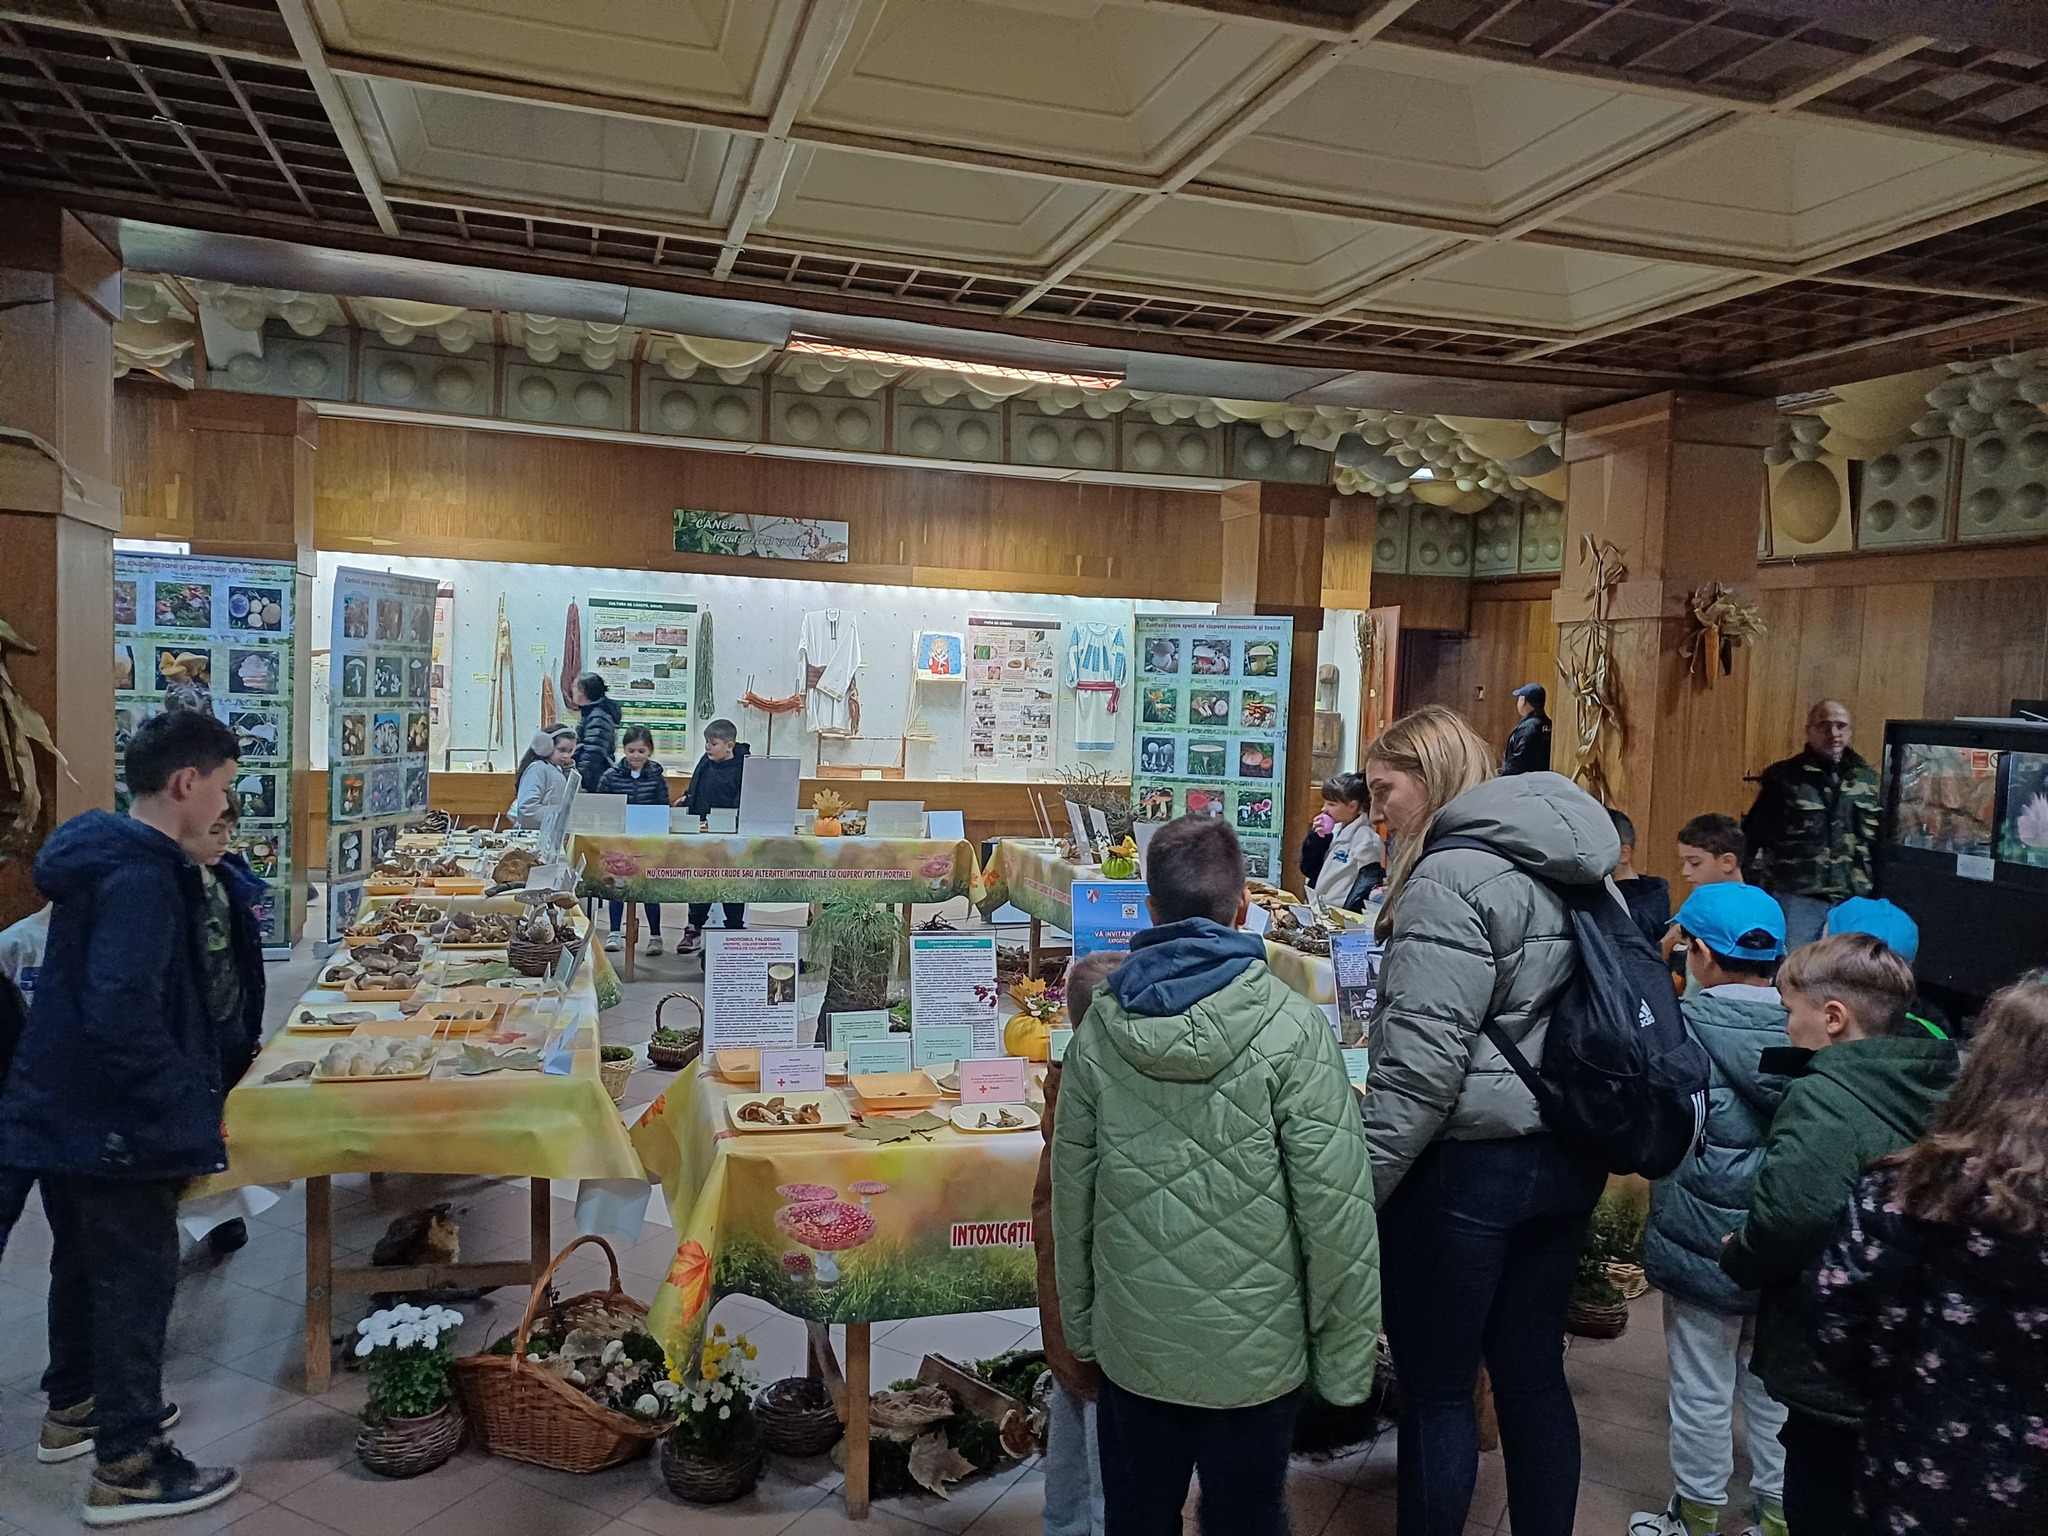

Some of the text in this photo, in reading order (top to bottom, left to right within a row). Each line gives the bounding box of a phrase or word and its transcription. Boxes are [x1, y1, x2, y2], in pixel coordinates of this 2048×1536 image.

[127, 559, 159, 568] ciuperci
[161, 562, 178, 570] rare
[228, 566, 241, 574] din
[242, 566, 276, 576] România
[1206, 623, 1226, 631] ciuperci
[1227, 623, 1258, 631] comestibile
[646, 869, 656, 878] NU
[693, 869, 720, 878] CIUPERCI
[721, 869, 741, 878] CRUDE
[742, 869, 753, 878] SAU
[828, 870, 836, 878] CU
[838, 870, 862, 879] CIUPERCI
[864, 870, 875, 878] POT
[876, 870, 882, 879] FI
[952, 1221, 1035, 1249] INTOXICAȚII
